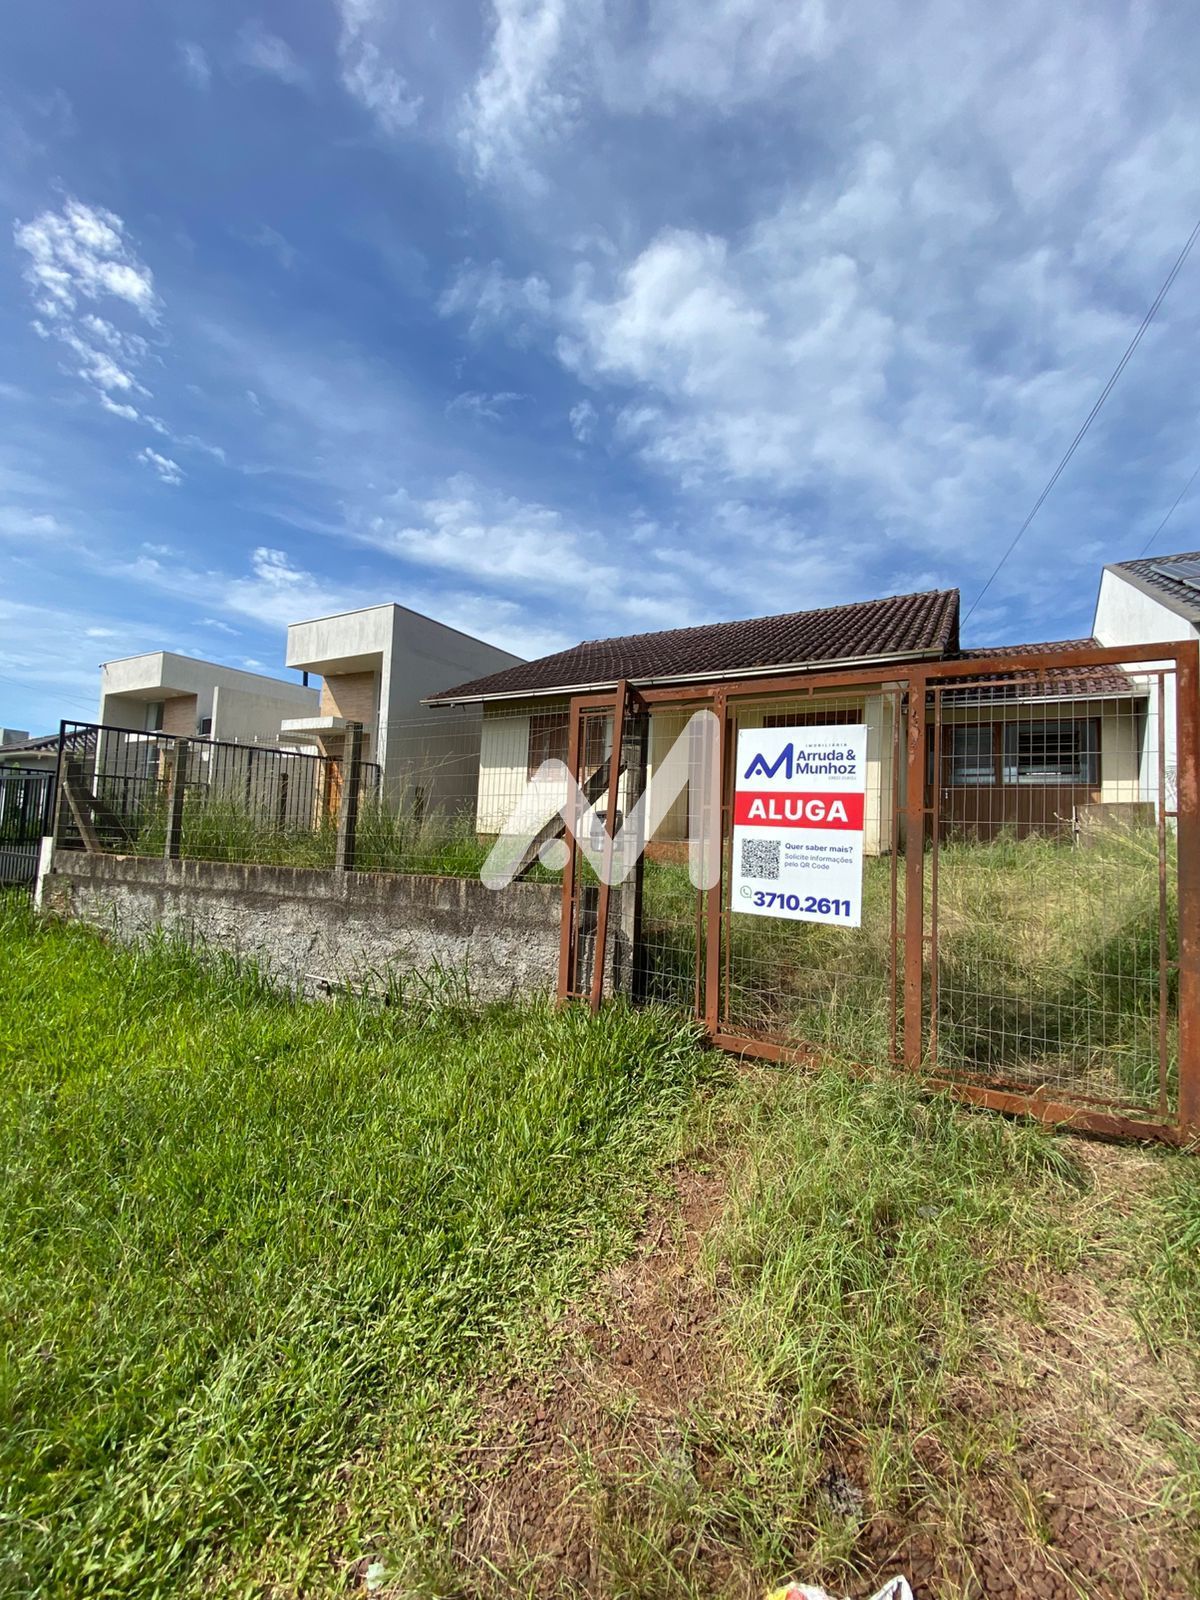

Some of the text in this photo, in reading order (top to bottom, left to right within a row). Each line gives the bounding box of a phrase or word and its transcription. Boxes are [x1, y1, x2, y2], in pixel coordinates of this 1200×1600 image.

[796, 749, 856, 761] Arruda &
[795, 762, 856, 774] Munhoz
[747, 798, 849, 822] ALUGA
[805, 844, 828, 852] saber
[829, 845, 853, 853] mais?
[784, 853, 853, 864] Solicite informações
[811, 862, 830, 870] Code
[753, 891, 851, 917] 3710.2611
